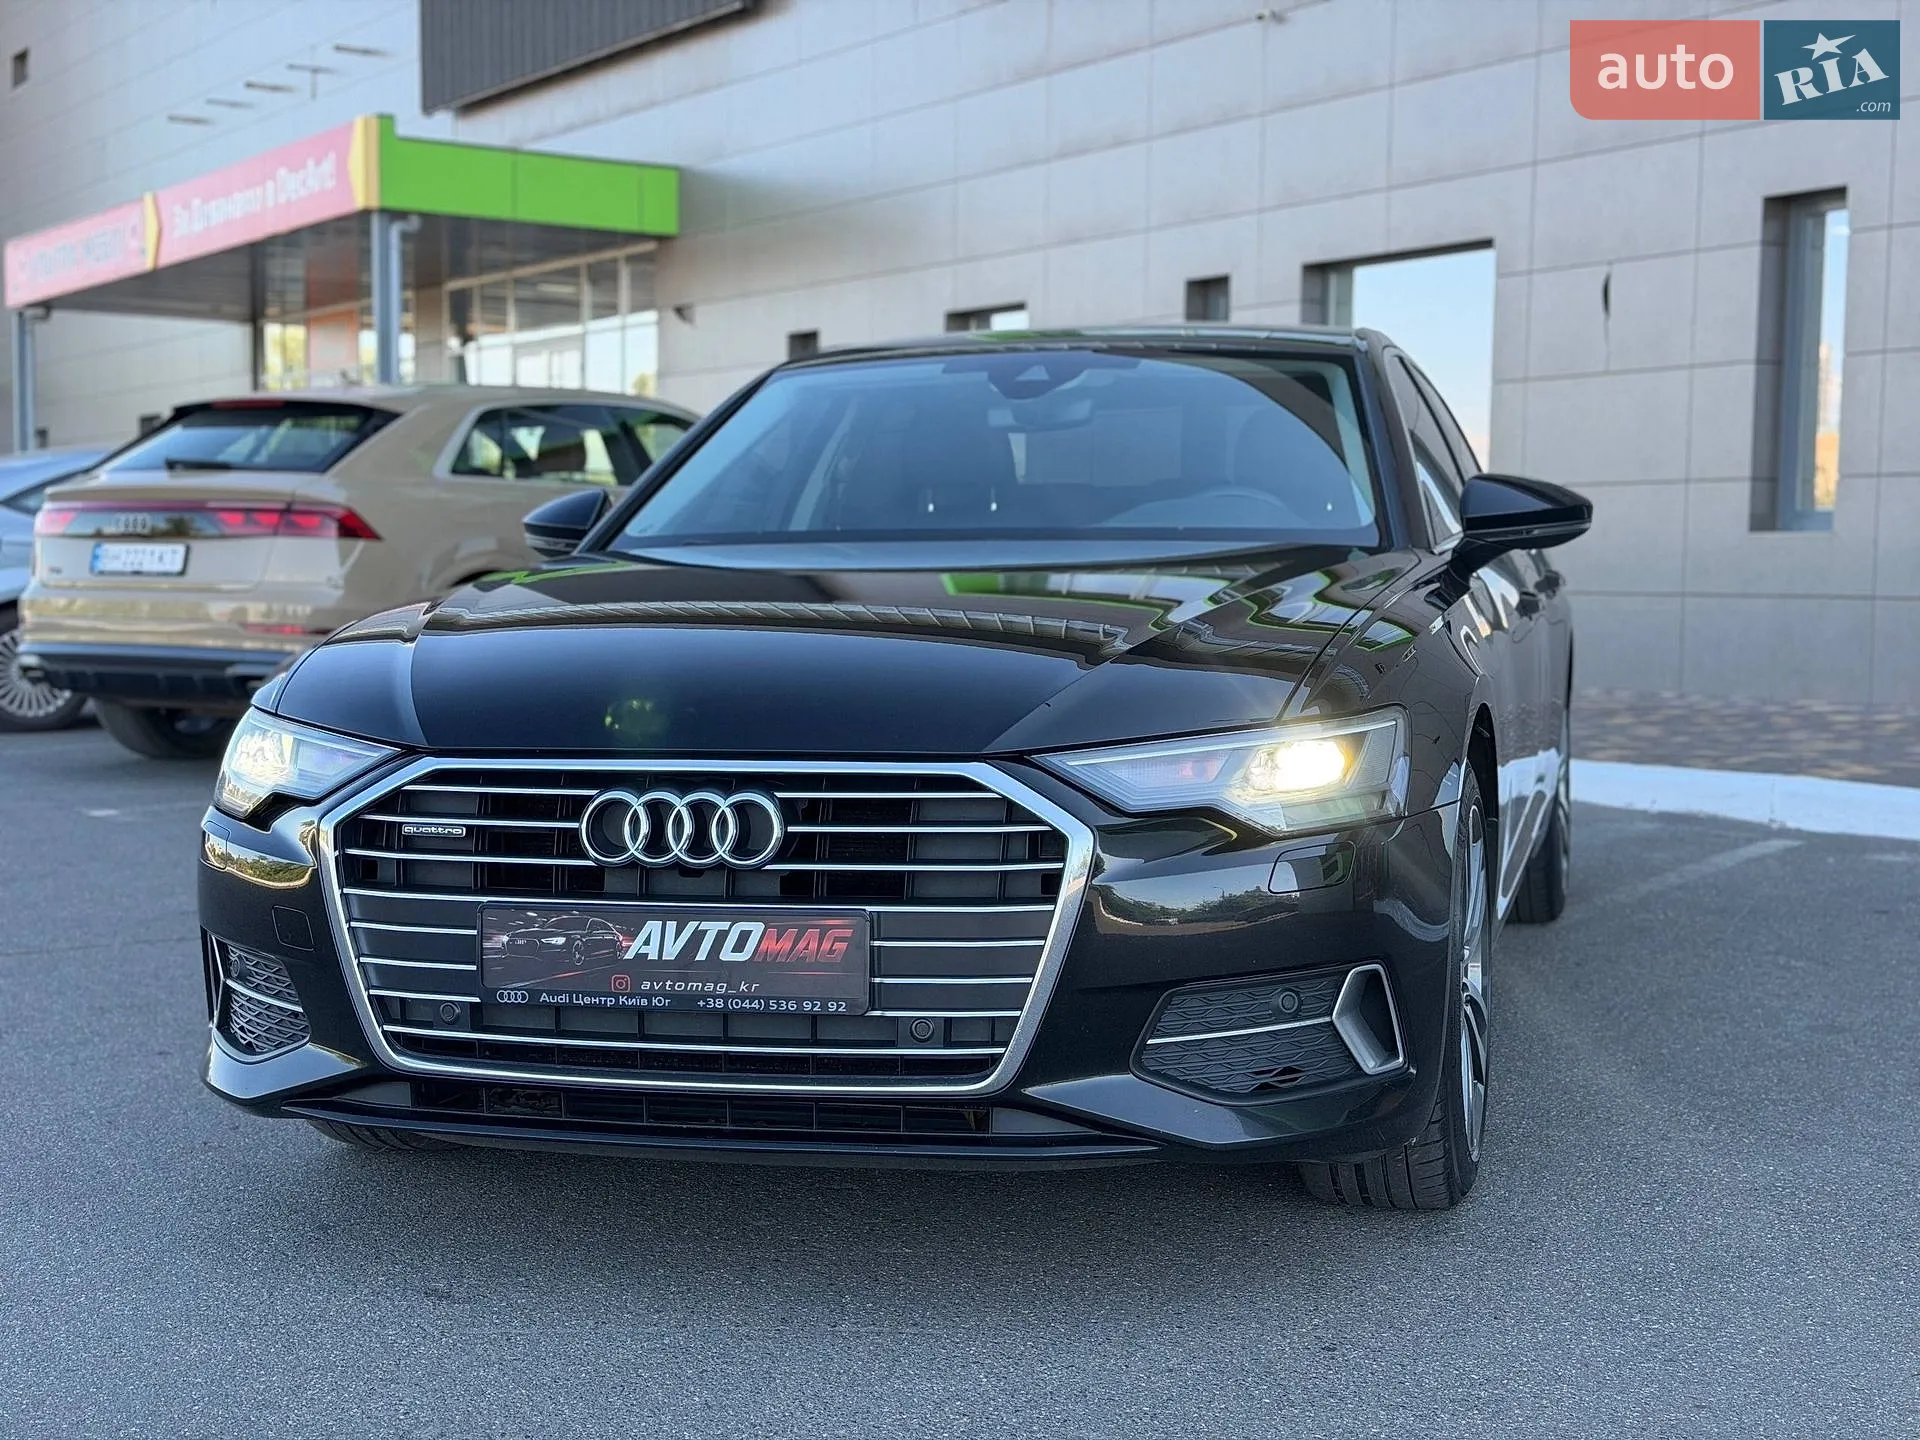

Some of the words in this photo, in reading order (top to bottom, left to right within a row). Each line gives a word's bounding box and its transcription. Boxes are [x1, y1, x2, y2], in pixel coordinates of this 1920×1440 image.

[404, 826, 462, 834] quattro
[640, 980, 760, 994] avtomag_kr
[539, 993, 569, 1004] Audi
[572, 993, 615, 1007] Центр
[619, 995, 648, 1006] Київ
[652, 996, 671, 1007] Юг
[697, 998, 724, 1009] +38
[727, 999, 765, 1011] (044)
[768, 1000, 797, 1011] 536
[803, 1001, 821, 1012] 92
[828, 1001, 847, 1012] 92
